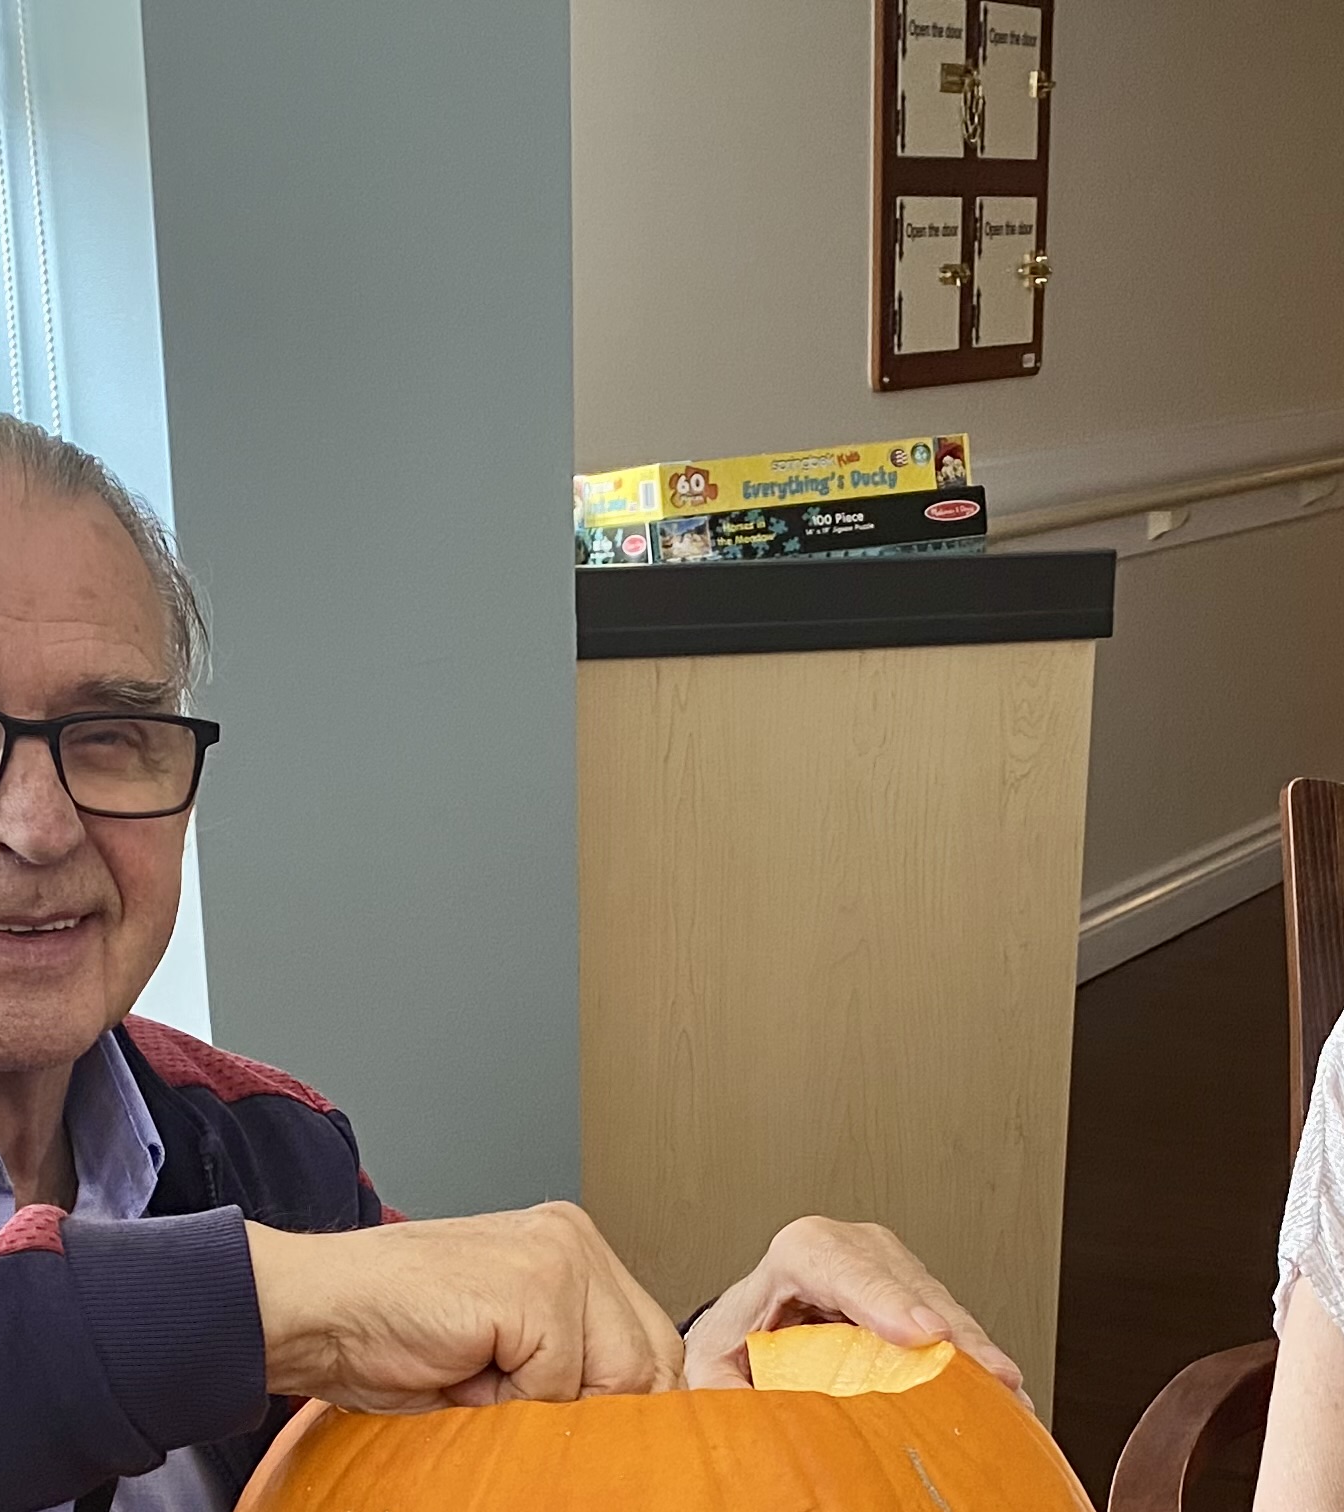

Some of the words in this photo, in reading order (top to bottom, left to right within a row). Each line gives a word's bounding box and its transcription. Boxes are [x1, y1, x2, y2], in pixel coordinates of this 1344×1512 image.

[909, 19, 931, 40] Open
[932, 22, 944, 38] the
[945, 23, 963, 39] door
[989, 27, 1008, 46] Open
[1009, 30, 1020, 45] the
[1021, 30, 1037, 47] door
[906, 222, 927, 241] Open
[928, 222, 939, 237] the
[942, 222, 958, 237] door
[985, 221, 1004, 240] Open
[1005, 221, 1016, 235] the
[1018, 220, 1033, 235] door
[677, 473, 705, 494] 60
[742, 472, 845, 500] Everything's
[850, 465, 898, 489] Ducky
[811, 513, 832, 526] 100
[835, 512, 864, 524] Piece
